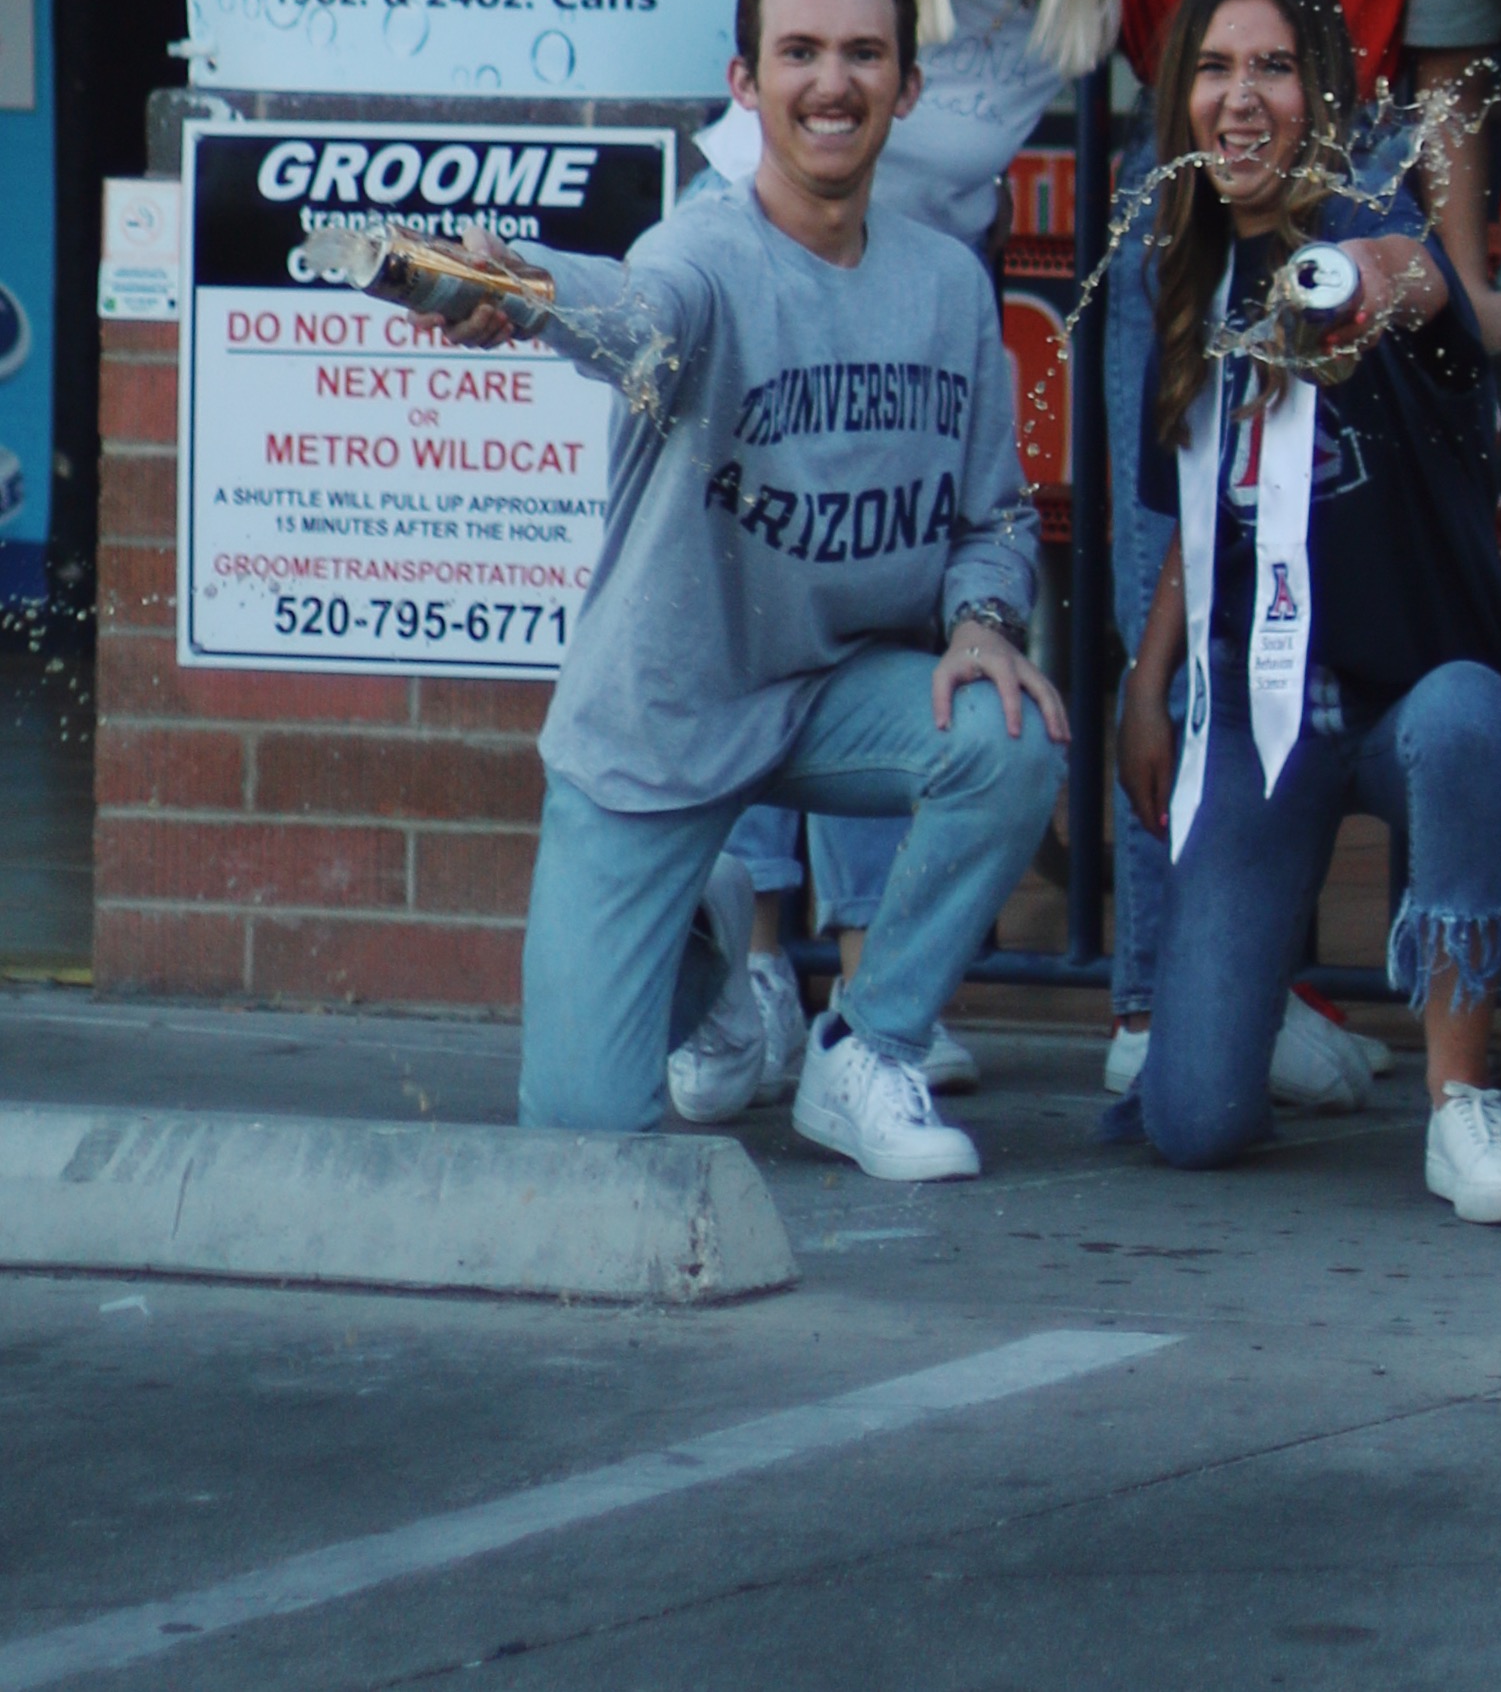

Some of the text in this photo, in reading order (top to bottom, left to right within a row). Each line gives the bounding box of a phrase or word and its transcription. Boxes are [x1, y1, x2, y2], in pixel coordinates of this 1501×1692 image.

[256, 141, 598, 209] GROOME
[226, 311, 284, 346] DO
[293, 312, 371, 347] NOT
[315, 365, 534, 404] NEXT CARE
[936, 369, 968, 440] OF
[408, 408, 440, 428] OR
[265, 433, 585, 476] METRO WILDCAT
[213, 486, 231, 506] A
[231, 486, 324, 510] SHUTTLE
[326, 489, 375, 512] WILL
[378, 492, 429, 514] PULL
[435, 494, 465, 515] UP
[704, 461, 960, 564] ARIZONA
[274, 515, 572, 545] 15 MINUTES AFTER THE HOUR.
[1266, 562, 1299, 622] A
[273, 594, 569, 647] 520-795-6771
